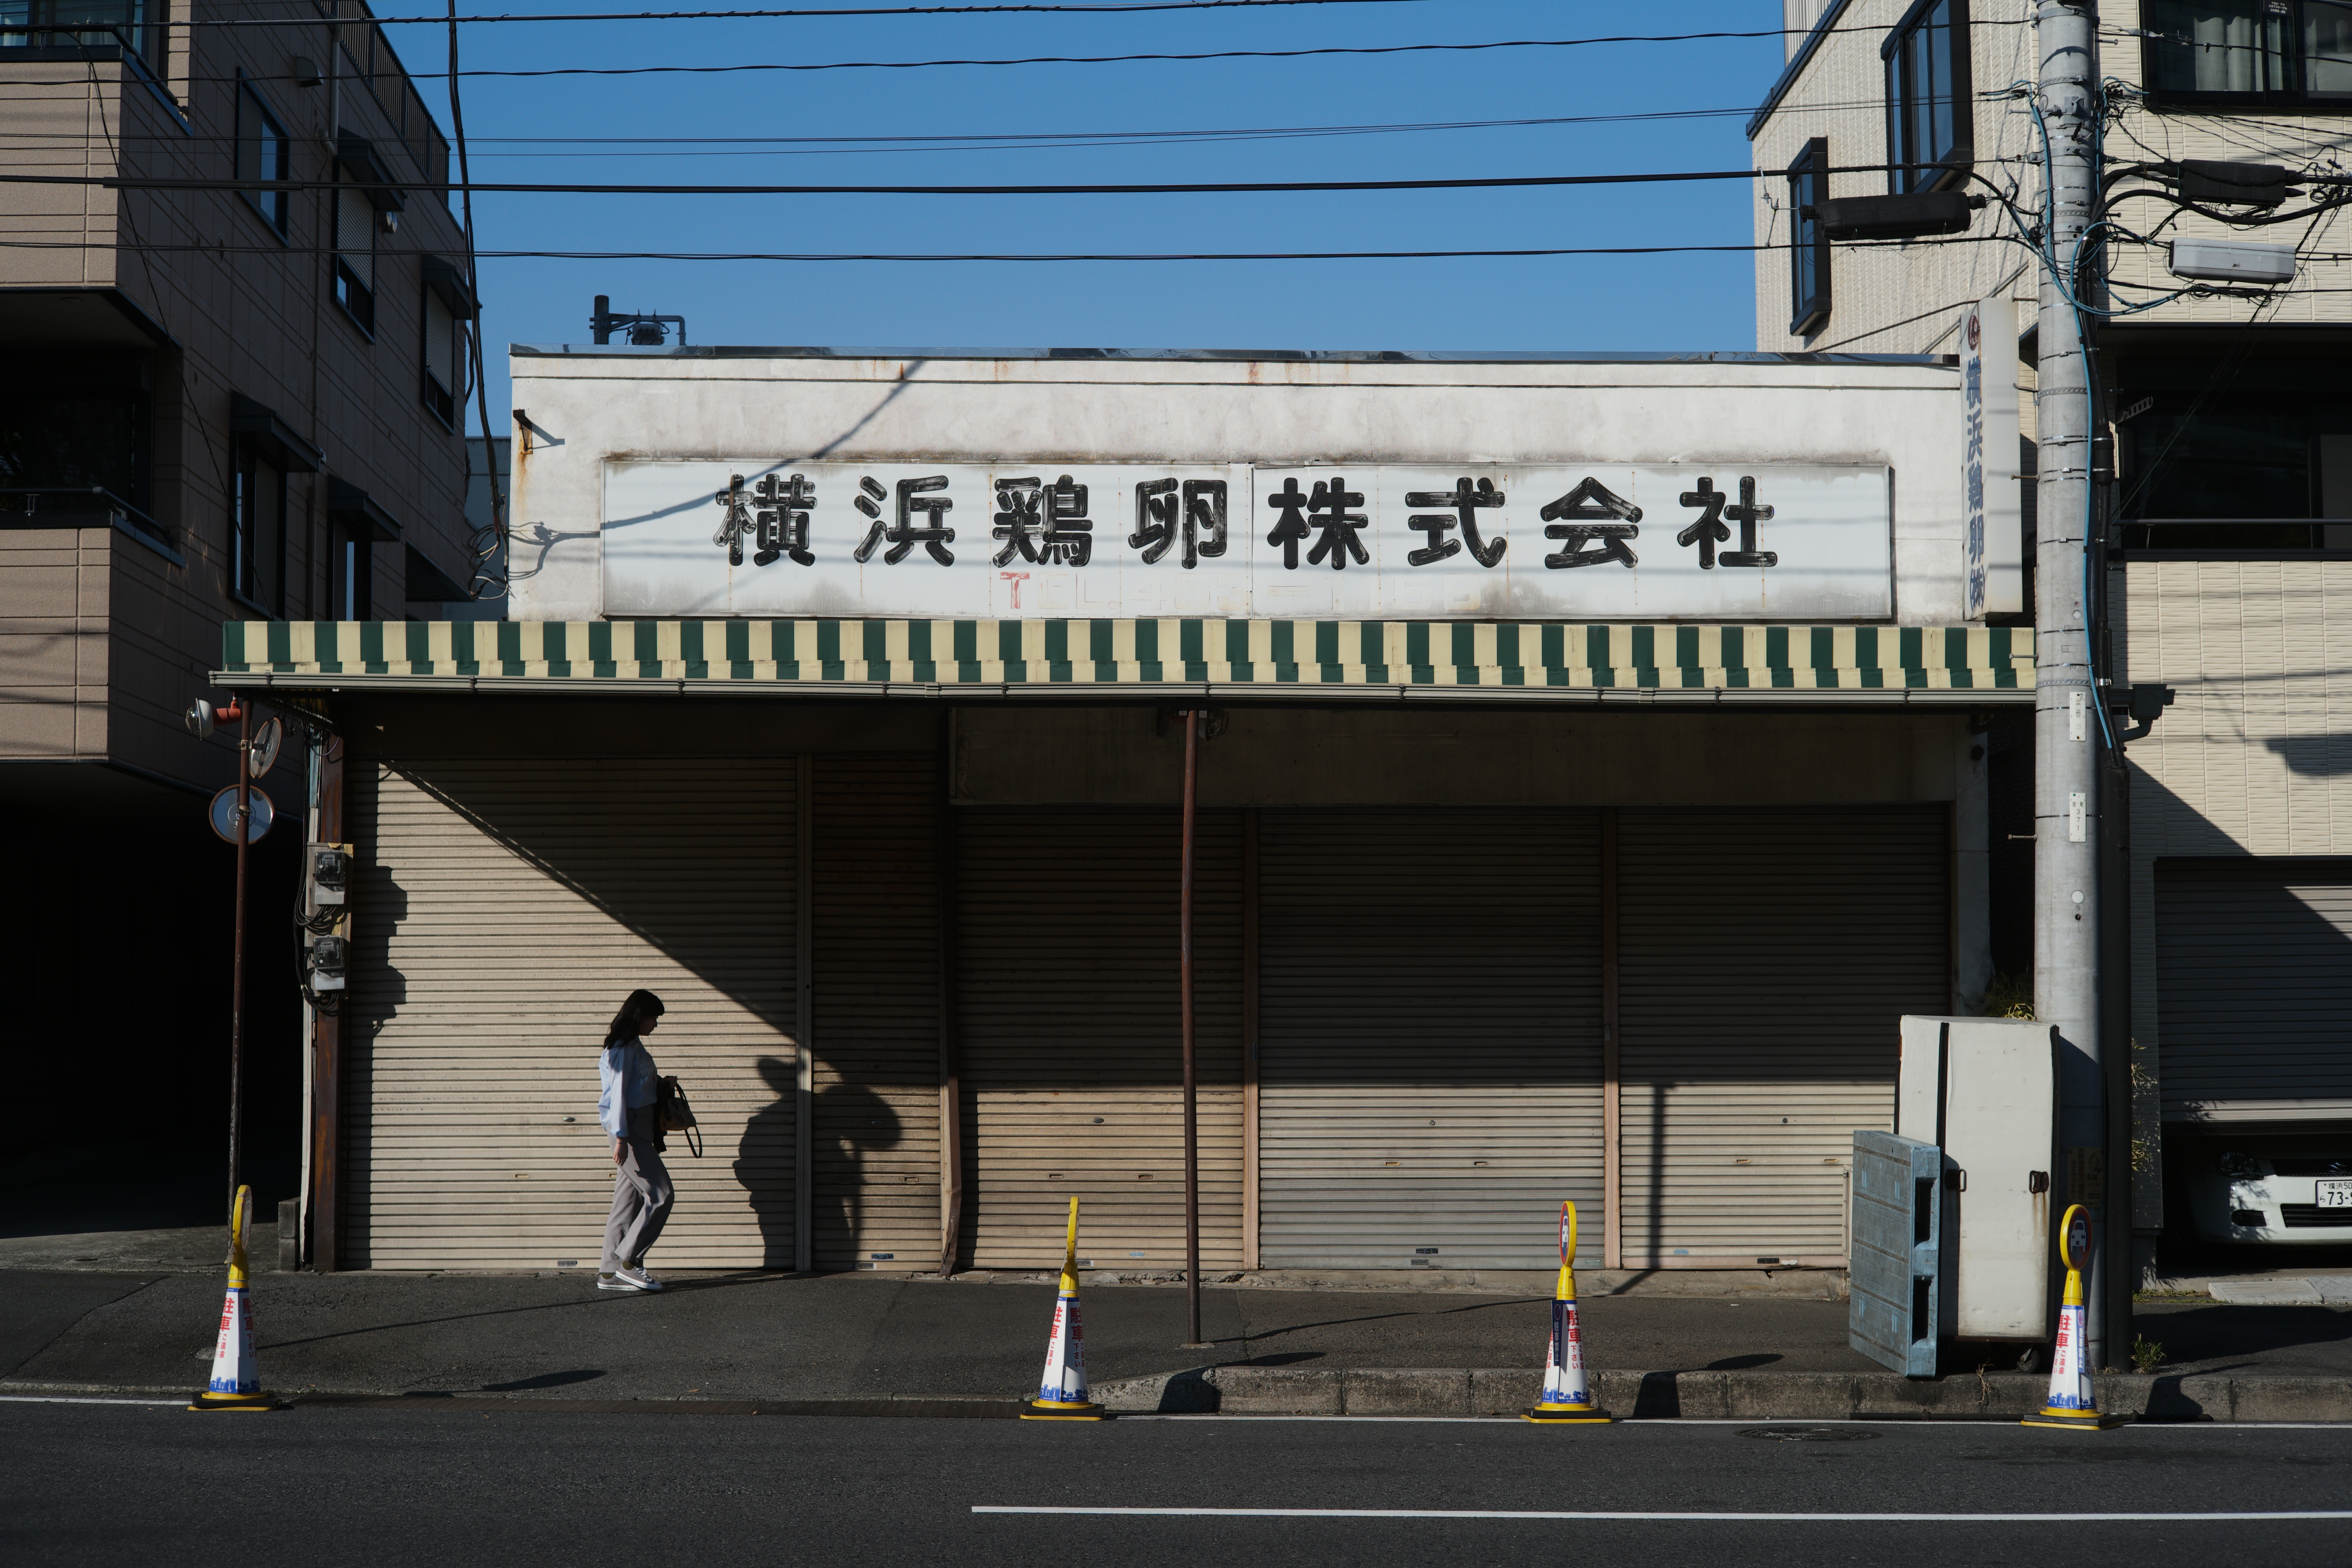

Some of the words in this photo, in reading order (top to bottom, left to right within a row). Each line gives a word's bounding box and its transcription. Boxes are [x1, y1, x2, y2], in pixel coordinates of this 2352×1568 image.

[713, 473, 1778, 570] 横浜鶏卵株式会社
[1566, 1310, 1582, 1343] 駐車
[2057, 1315, 2072, 1348] 駐車
